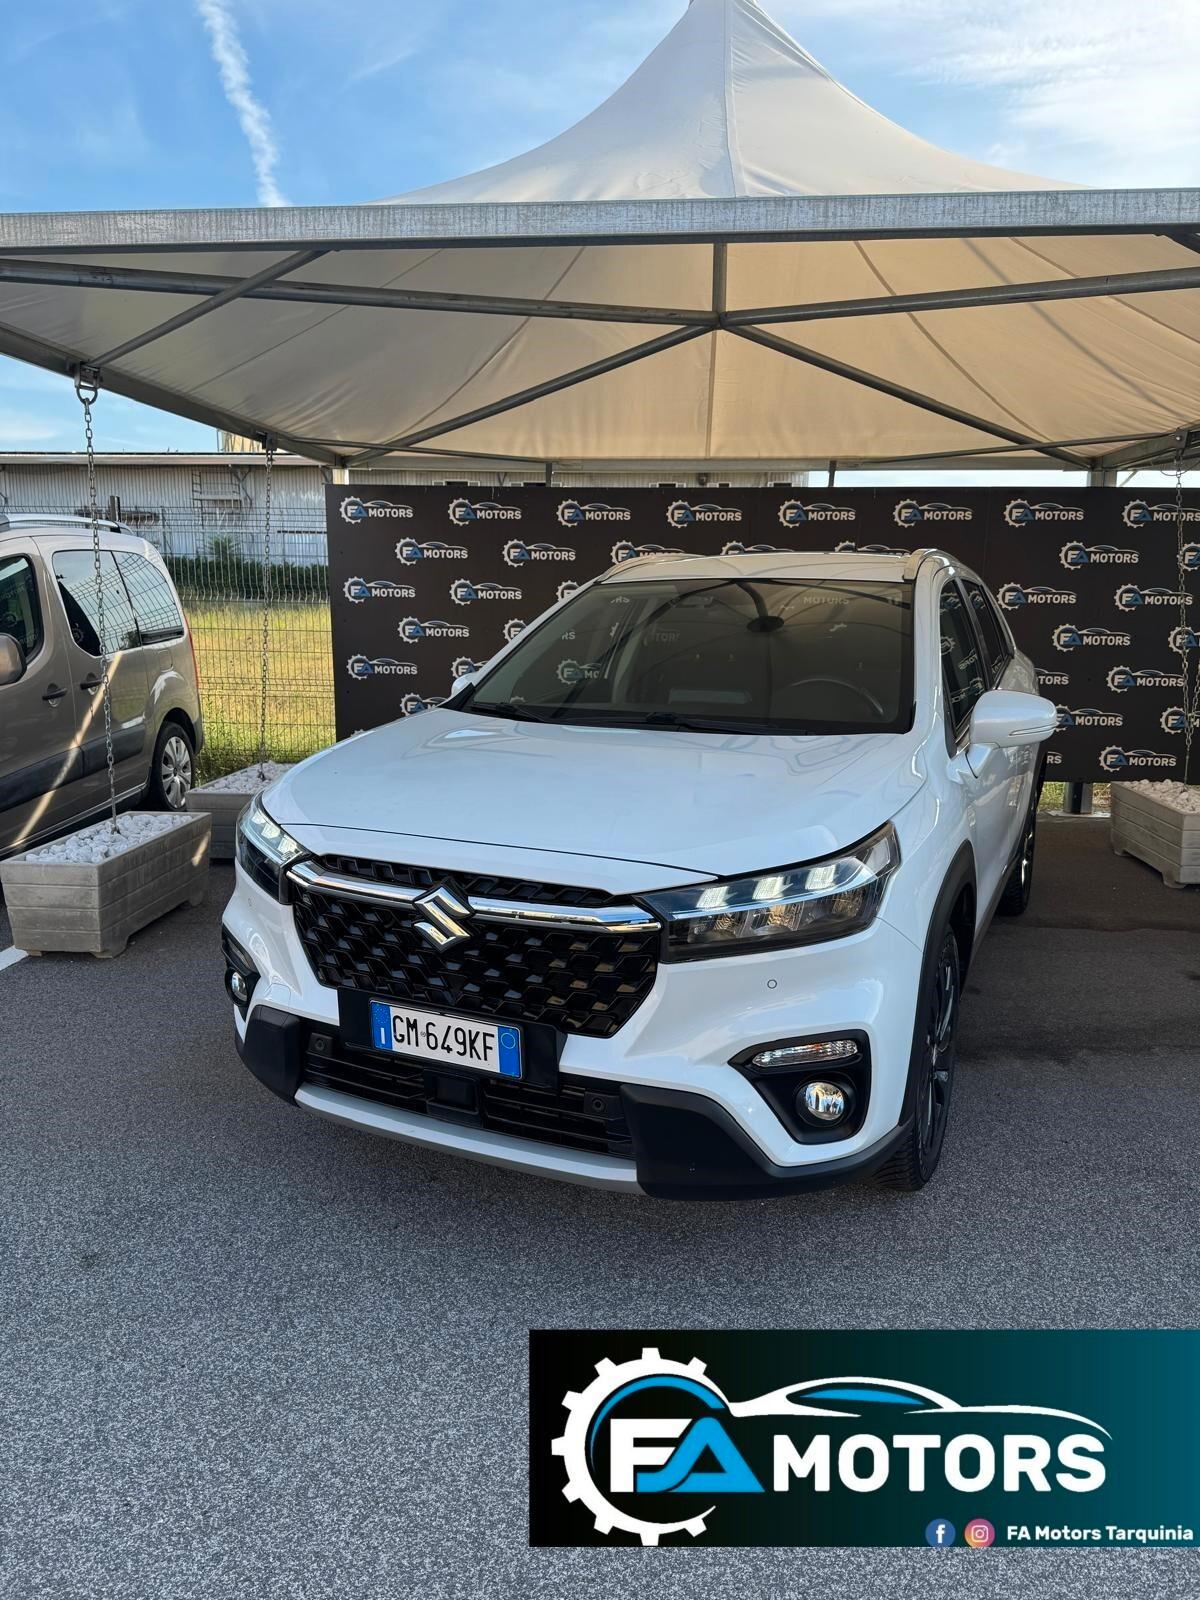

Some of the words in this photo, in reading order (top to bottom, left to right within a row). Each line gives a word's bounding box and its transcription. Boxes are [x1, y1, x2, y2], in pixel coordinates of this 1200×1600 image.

[347, 506, 367, 517] FA
[369, 509, 413, 517] MOTORS
[456, 507, 475, 519] FA
[477, 510, 521, 519] MOTORS
[564, 509, 584, 520] FA
[586, 511, 631, 520] MOTORS
[674, 511, 694, 522] FA
[696, 512, 742, 521] MOTORS
[786, 510, 807, 521] FA
[808, 511, 855, 521] MOTORS
[901, 509, 922, 520] FA
[924, 511, 972, 520] MOTORS
[1012, 509, 1033, 520] FA
[1035, 510, 1084, 520] MOTORS
[1130, 510, 1152, 520] FA
[403, 547, 422, 559] FA
[424, 549, 468, 559] MOTORS
[510, 548, 530, 560] FA
[531, 551, 575, 560] MOTORS
[1067, 551, 1088, 563] FA
[1090, 553, 1139, 563] MOTORS
[351, 586, 370, 597] FA
[372, 588, 416, 597] MOTORS
[457, 588, 477, 599] FA
[478, 590, 522, 600] MOTORS
[1005, 592, 1026, 604] FA
[1028, 594, 1076, 604] MOTORS
[1122, 593, 1143, 605] FA
[405, 626, 424, 636] FA
[425, 628, 469, 637] MOTORS
[1060, 634, 1081, 646] FA
[1083, 636, 1130, 646] MOTORS
[354, 663, 373, 674] FA
[375, 665, 417, 674] MOTORS
[1038, 676, 1069, 685] TORS
[1114, 675, 1136, 686] FA
[1137, 677, 1184, 686] MOTORS
[1075, 716, 1123, 726] MOTORS
[1107, 755, 1128, 766] FA
[1129, 757, 1177, 767] MOTORS
